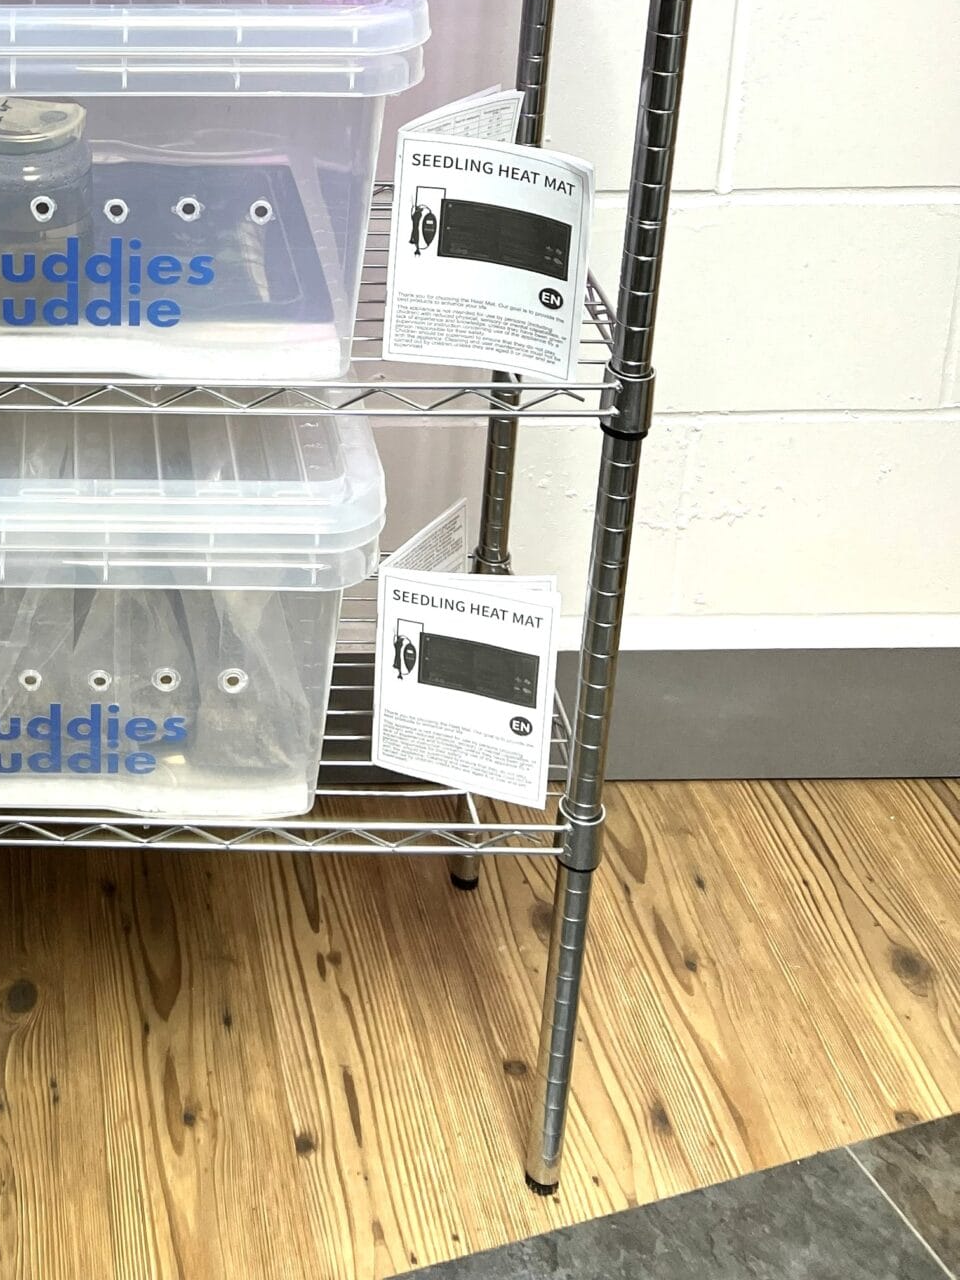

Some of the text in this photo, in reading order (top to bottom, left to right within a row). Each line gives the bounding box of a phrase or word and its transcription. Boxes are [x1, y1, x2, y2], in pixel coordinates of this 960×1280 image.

[412, 153, 576, 197] SEEDLING HEAT MAT
[541, 292, 561, 307] EN
[392, 589, 544, 629] SEEDLING HEAT MAT
[511, 720, 531, 734] EN
